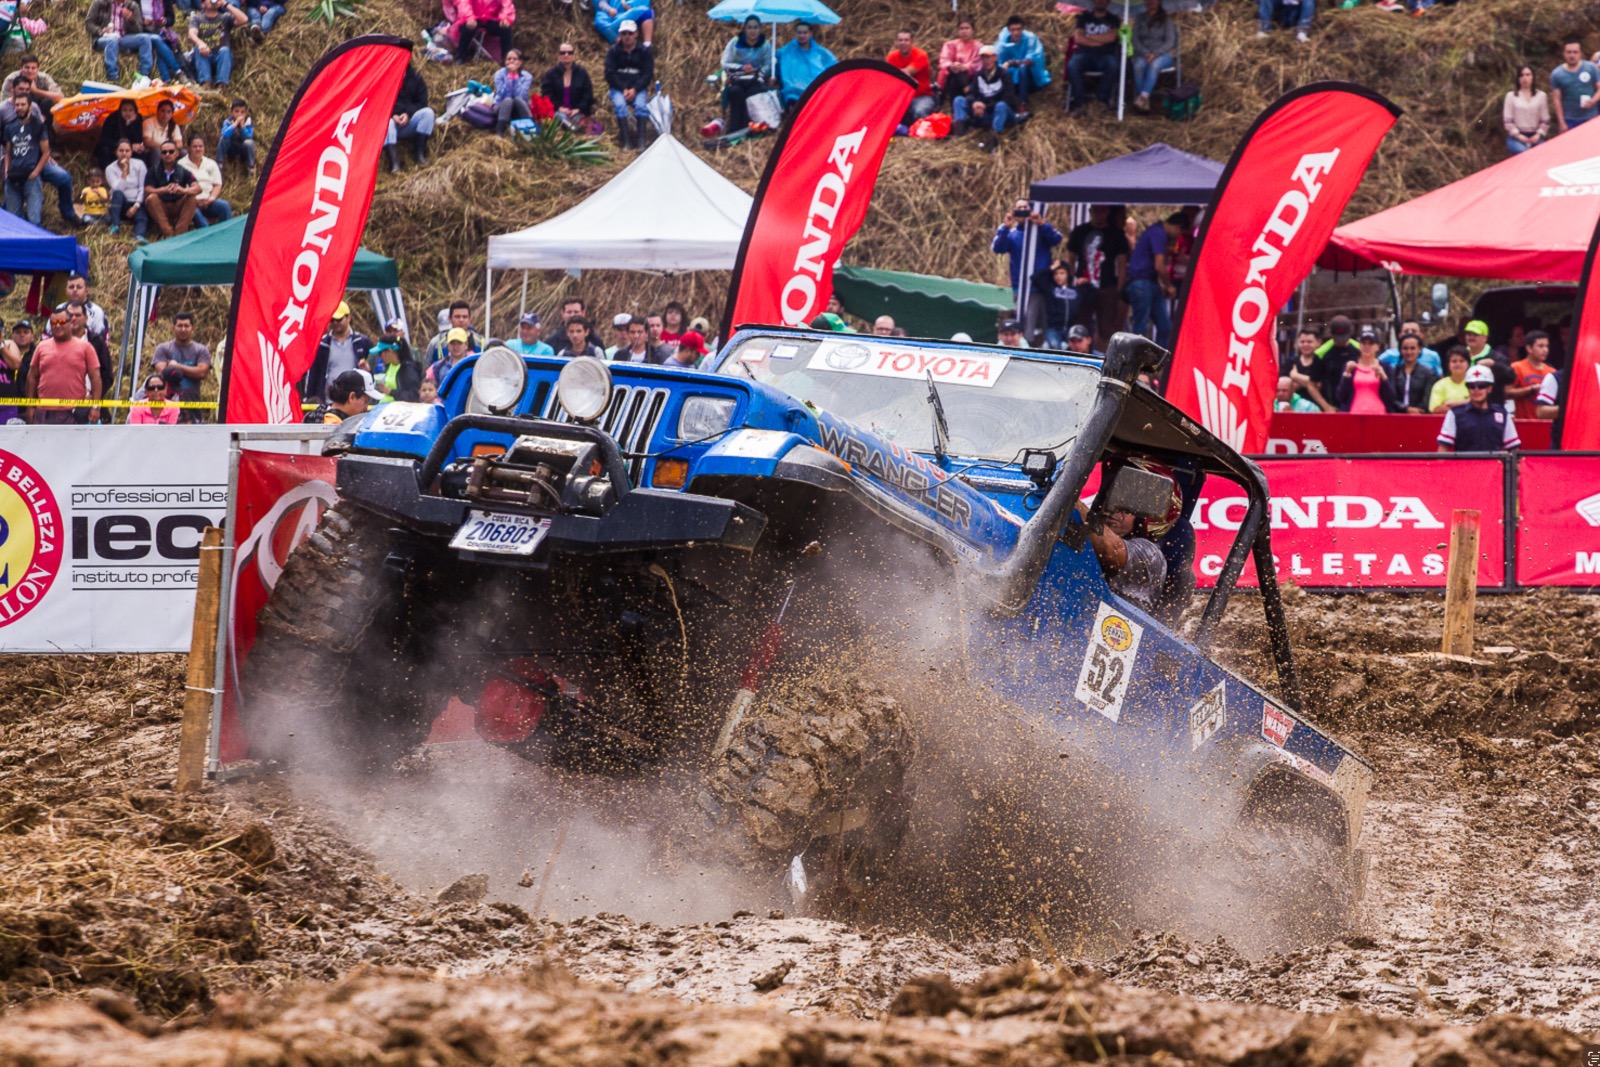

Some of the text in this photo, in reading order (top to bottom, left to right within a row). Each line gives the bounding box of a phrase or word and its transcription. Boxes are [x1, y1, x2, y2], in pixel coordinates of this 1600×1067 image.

[277, 97, 368, 352] HONDA
[780, 126, 868, 326] ONDA
[1221, 147, 1341, 397] HONDA
[877, 351, 990, 380] TOYOTA
[71, 488, 195, 506] professional
[818, 420, 972, 531] WRANGLER
[6, 465, 55, 555] BELLEZA
[465, 520, 539, 545] 206803
[491, 514, 530, 525] COSTA RICA
[72, 570, 148, 583] instituto
[1087, 642, 1124, 706] 52
